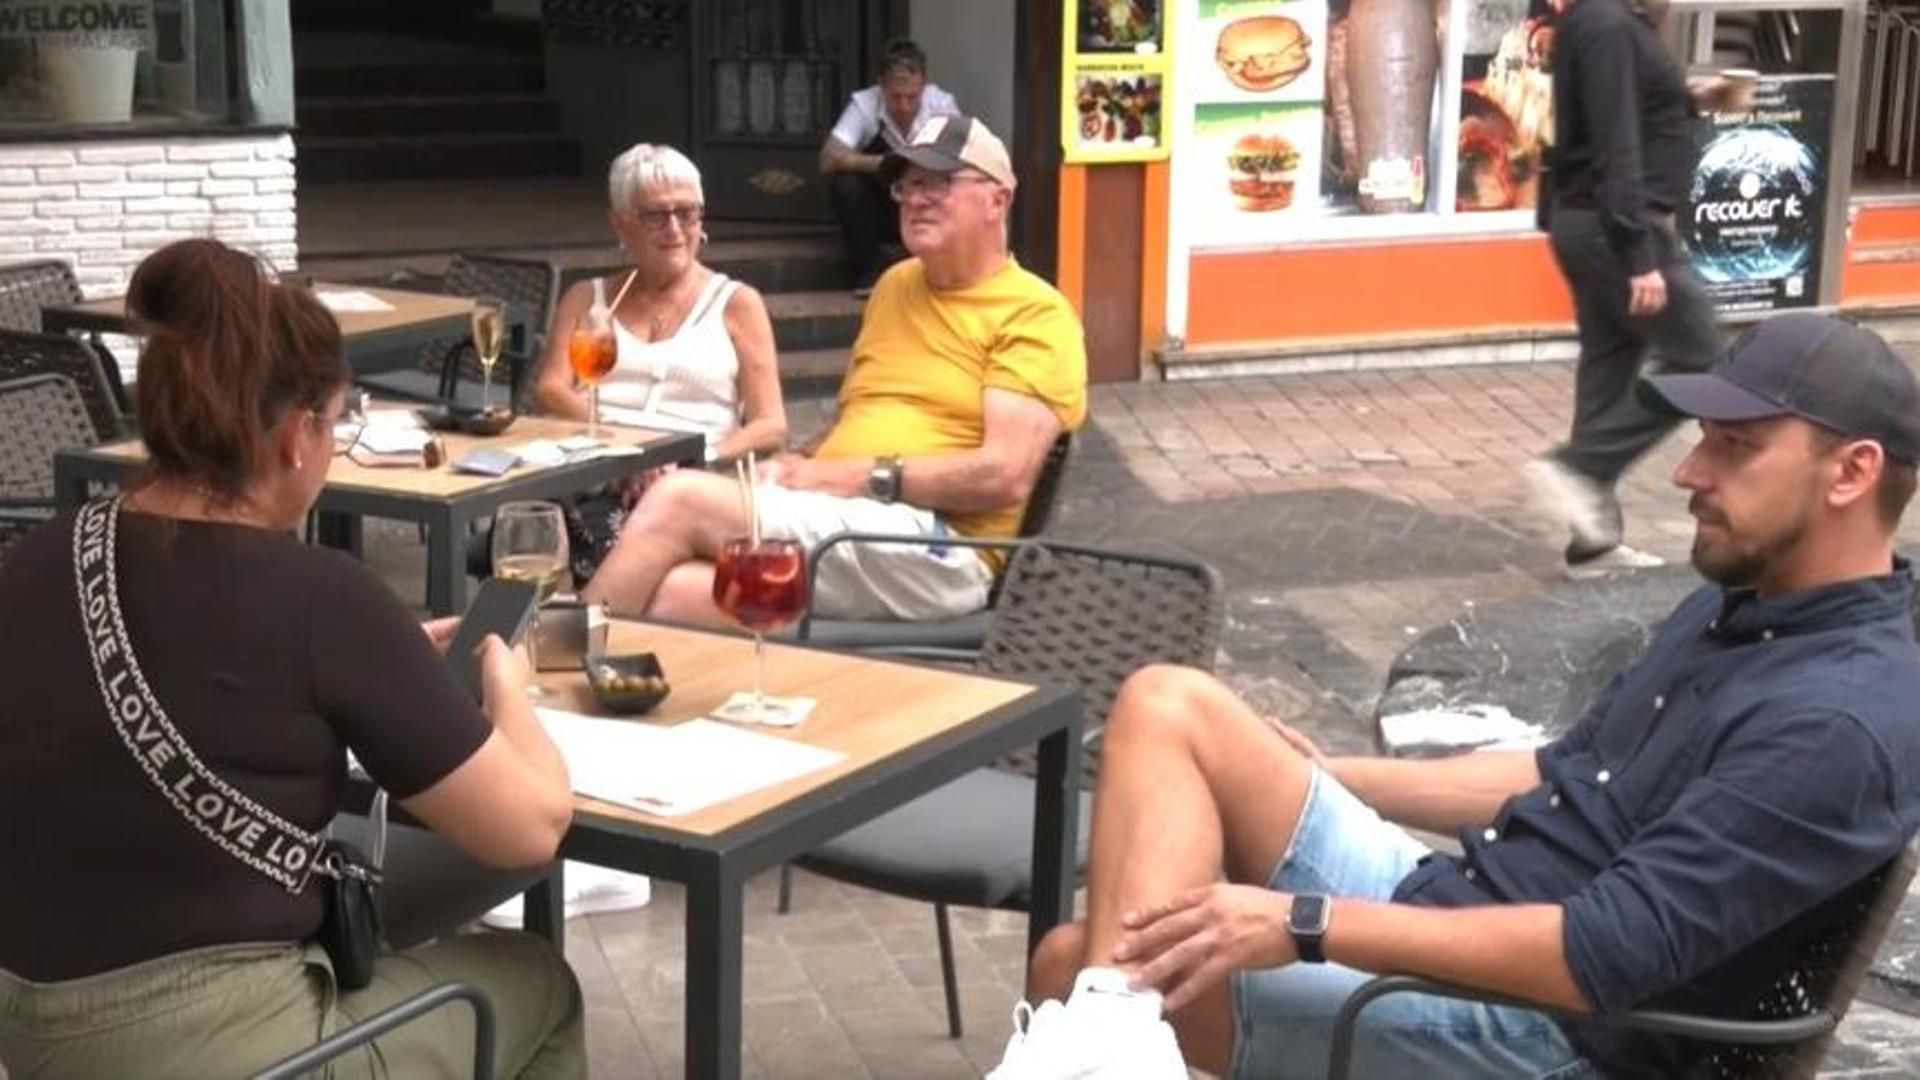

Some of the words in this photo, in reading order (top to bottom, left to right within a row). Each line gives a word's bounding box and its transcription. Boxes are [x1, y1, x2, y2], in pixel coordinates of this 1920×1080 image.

[1695, 198, 1782, 223] recover
[82, 499, 111, 570] LOVE
[86, 574, 118, 663] LOVE
[109, 669, 176, 770] LOVE
[173, 772, 267, 848] LOVE
